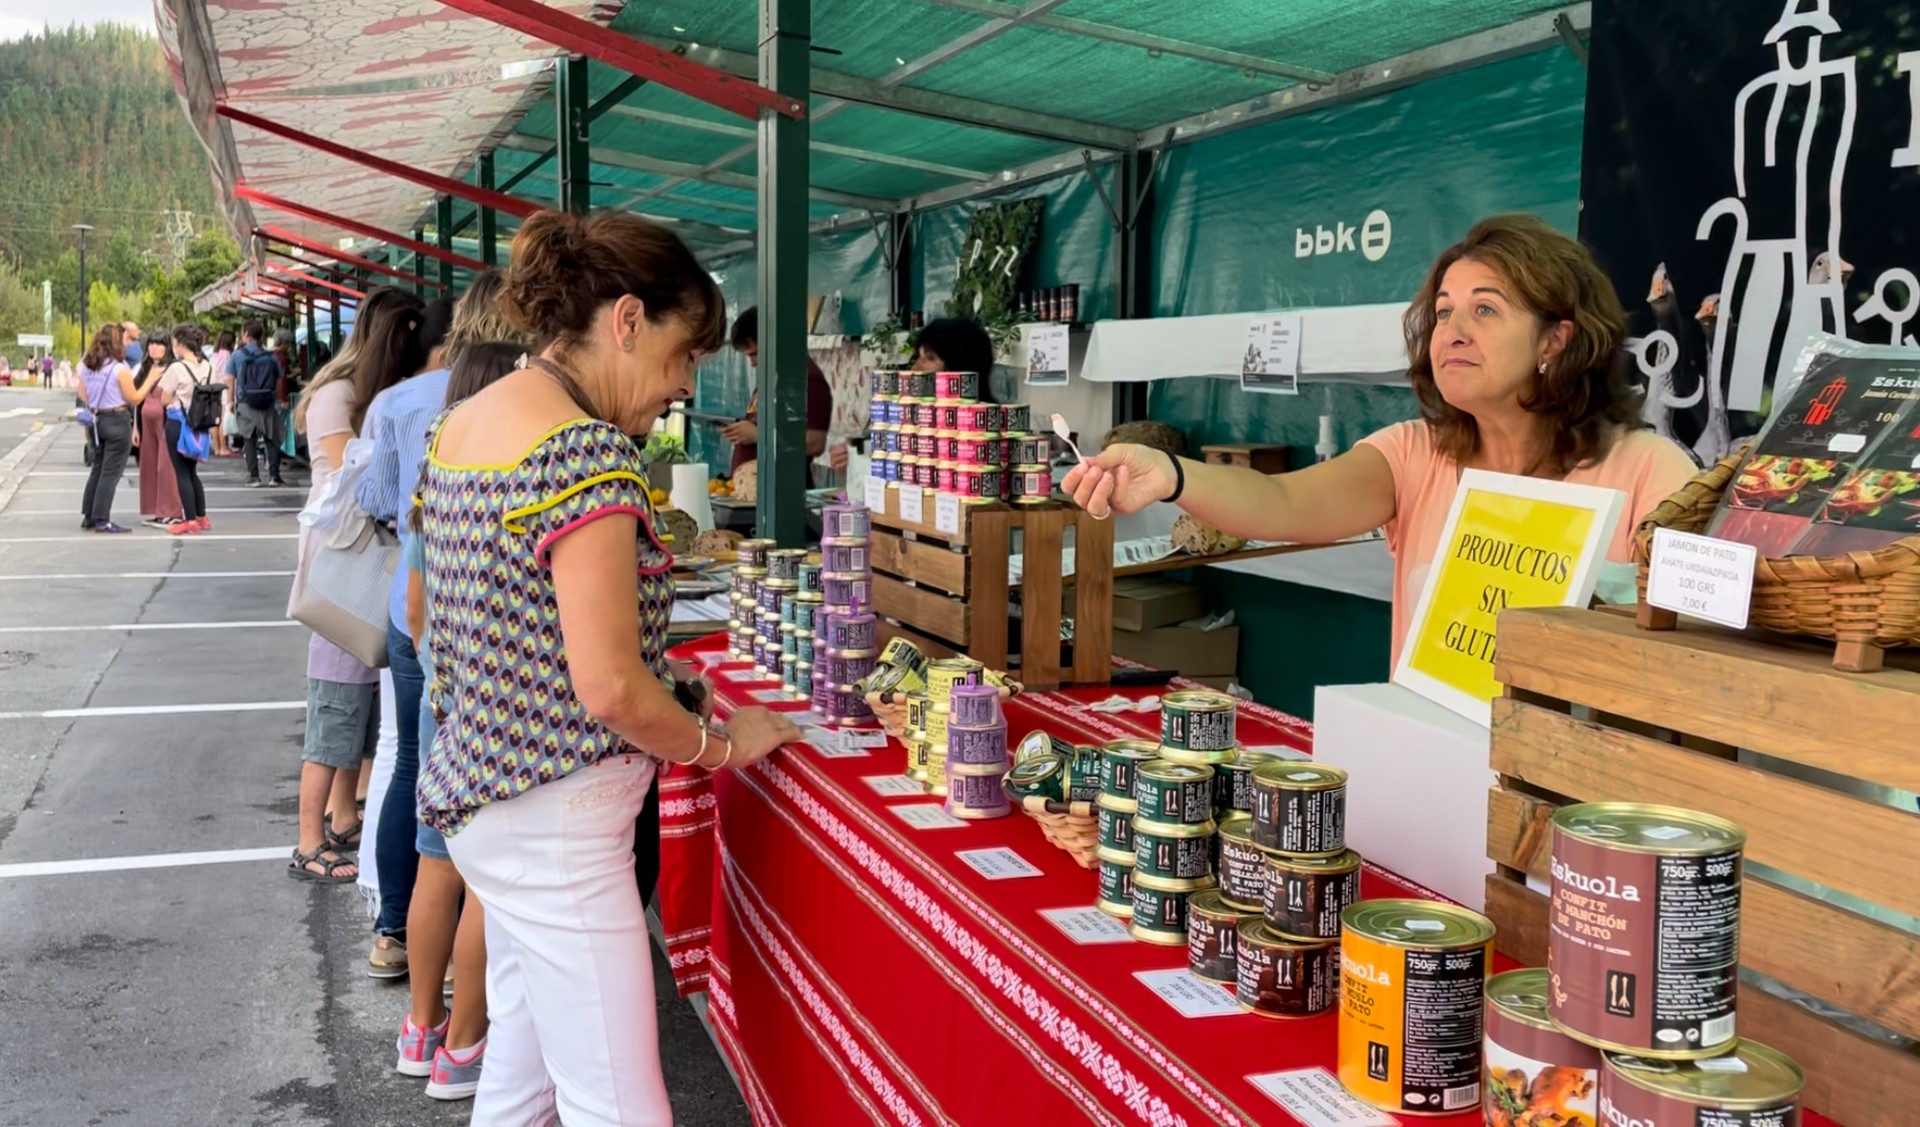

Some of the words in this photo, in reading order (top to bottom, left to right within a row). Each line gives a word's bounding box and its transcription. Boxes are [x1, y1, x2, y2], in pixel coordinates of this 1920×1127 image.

[1295, 221, 1356, 258] bbk
[1456, 533, 1572, 585] PRODUCTOS
[1661, 556, 1684, 569] AHATE
[1700, 545, 1711, 557] DE
[1713, 548, 1737, 561] PATO
[1679, 577, 1696, 589] 100
[1697, 581, 1716, 595] GRS
[1477, 584, 1513, 615] SIN
[1682, 596, 1700, 609] 7,00
[1224, 844, 1265, 862] Eskuol
[1560, 888, 1607, 913] CONFIT
[1558, 912, 1570, 927] DE
[1575, 921, 1611, 940] PATO
[1565, 904, 1628, 931] MANCHÓN
[1347, 987, 1374, 1006] MUSLO
[1349, 999, 1371, 1015] PATO
